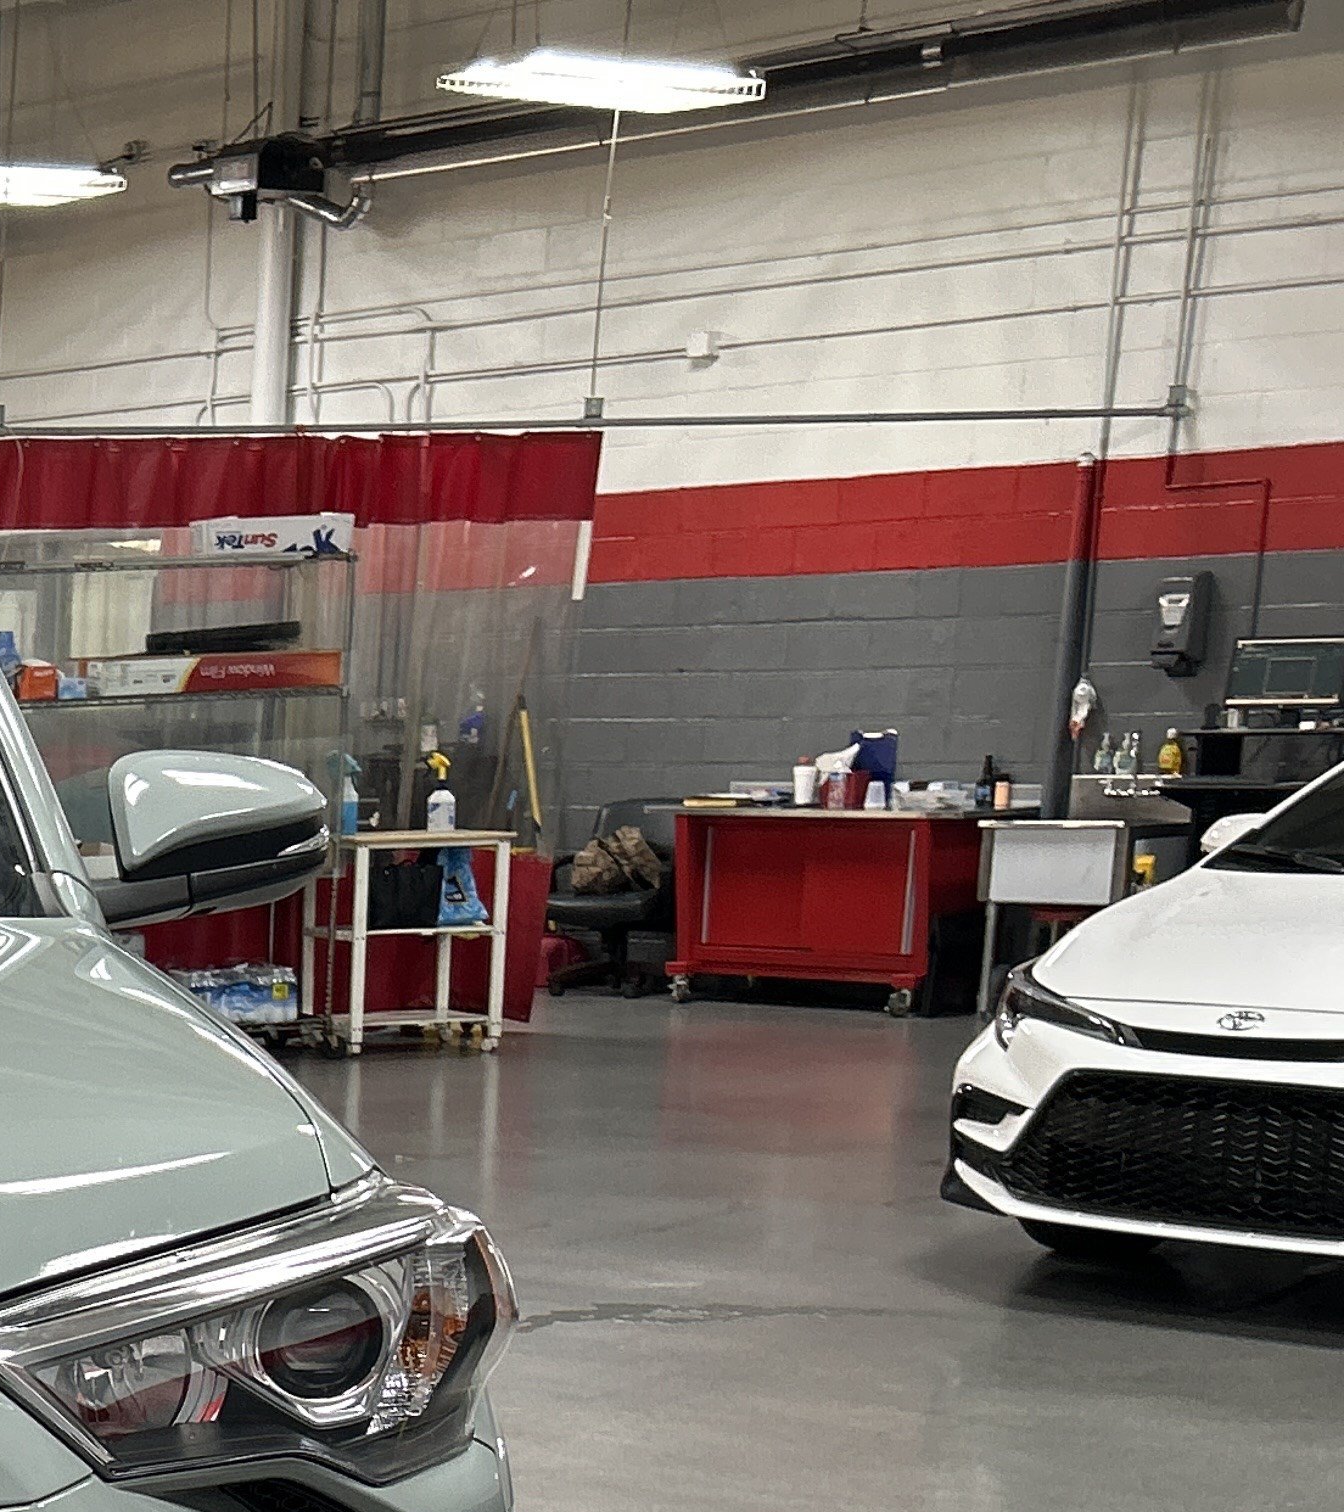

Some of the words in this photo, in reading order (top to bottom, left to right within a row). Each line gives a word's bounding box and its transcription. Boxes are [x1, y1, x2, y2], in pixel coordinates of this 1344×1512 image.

[214, 533, 278, 550] SunTek
[200, 664, 226, 679] Film
[227, 663, 276, 678] Window
